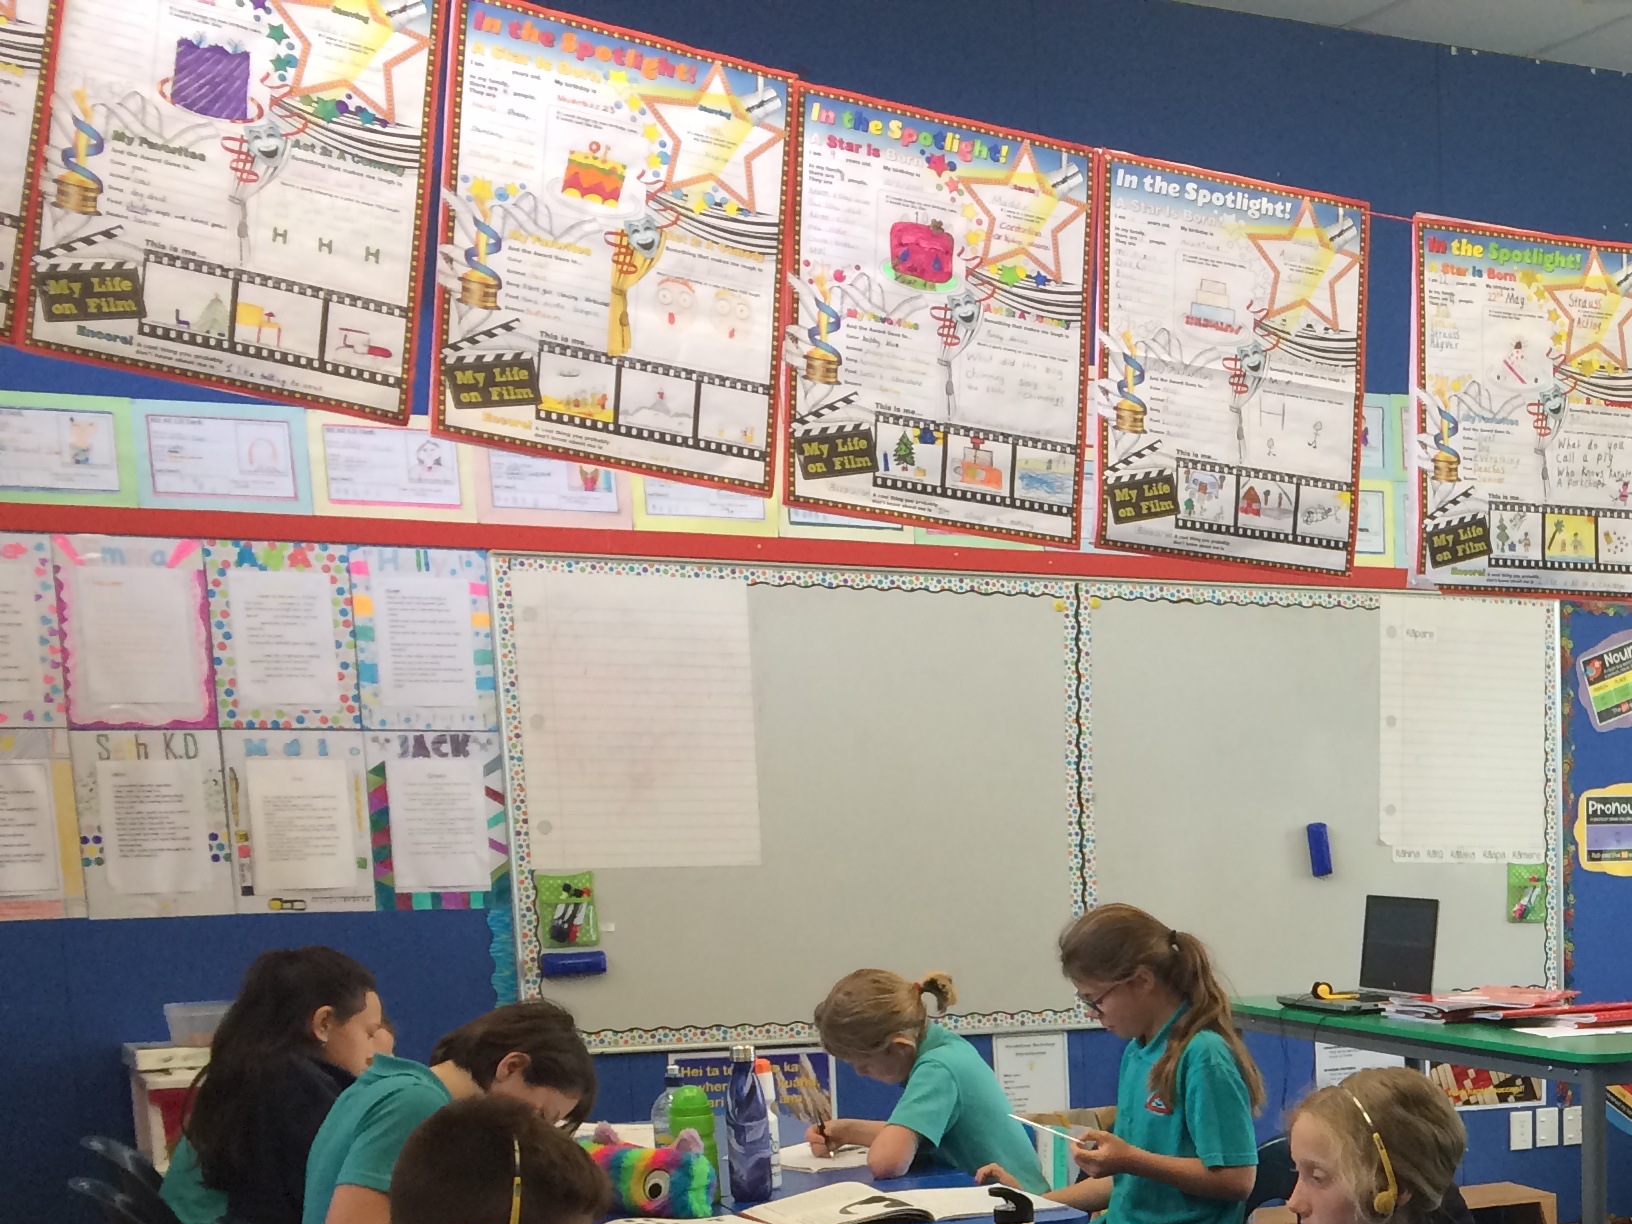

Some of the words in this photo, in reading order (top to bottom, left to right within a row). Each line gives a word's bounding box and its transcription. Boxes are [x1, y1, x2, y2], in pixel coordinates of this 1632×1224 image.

[473, 10, 502, 34] In
[508, 20, 555, 48] the
[560, 31, 697, 84] Spotlight!
[811, 102, 836, 125] In
[842, 111, 883, 135] the
[888, 120, 1008, 164] Spotlight!
[810, 133, 822, 146] A
[826, 134, 862, 153] Star
[867, 143, 880, 158] Is
[885, 148, 924, 167] Born
[1116, 169, 1138, 189] In
[1144, 175, 1181, 197] the
[1184, 182, 1292, 220] Spotlight!
[1115, 198, 1126, 209] A
[1130, 200, 1161, 216] Star
[1166, 205, 1178, 219] Is
[1183, 209, 1218, 225] Born
[146, 240, 165, 252] This
[169, 244, 178, 254] is
[1427, 235, 1447, 255] In
[1451, 238, 1483, 258] the
[1489, 242, 1582, 273] Spotlight!
[1429, 263, 1437, 273] A
[1441, 263, 1468, 277] Star
[1471, 266, 1483, 279] Is
[1487, 268, 1517, 282] Born
[50, 280, 81, 297] My
[91, 277, 132, 292] Life
[52, 302, 77, 314] on
[87, 298, 136, 312] Film
[1506, 293, 1525, 308] May
[540, 331, 557, 341] This
[455, 370, 485, 388] My
[494, 366, 528, 382] Life
[461, 391, 482, 403] on
[490, 386, 533, 401] Film
[875, 402, 891, 411] This
[803, 443, 828, 457] My
[836, 438, 867, 450] Life
[1558, 438, 1581, 449] What
[1588, 438, 1598, 449] do
[1608, 441, 1624, 456] you
[808, 462, 826, 472] on
[833, 456, 871, 470] Film
[1582, 455, 1588, 463] a
[1597, 451, 1613, 468] pig
[1558, 469, 1574, 478] Who
[1114, 489, 1137, 501] My
[1144, 483, 1170, 496] Life
[1557, 479, 1562, 488] A
[1119, 508, 1135, 517] on
[1142, 500, 1174, 513] Film
[1432, 533, 1453, 548] My
[1460, 525, 1483, 537] Life
[1436, 552, 1452, 562] on
[1457, 542, 1487, 555] Film
[397, 734, 471, 759] JACK
[681, 1066, 702, 1077] Hei
[707, 1067, 719, 1075] ta
[784, 1062, 798, 1072] ka
